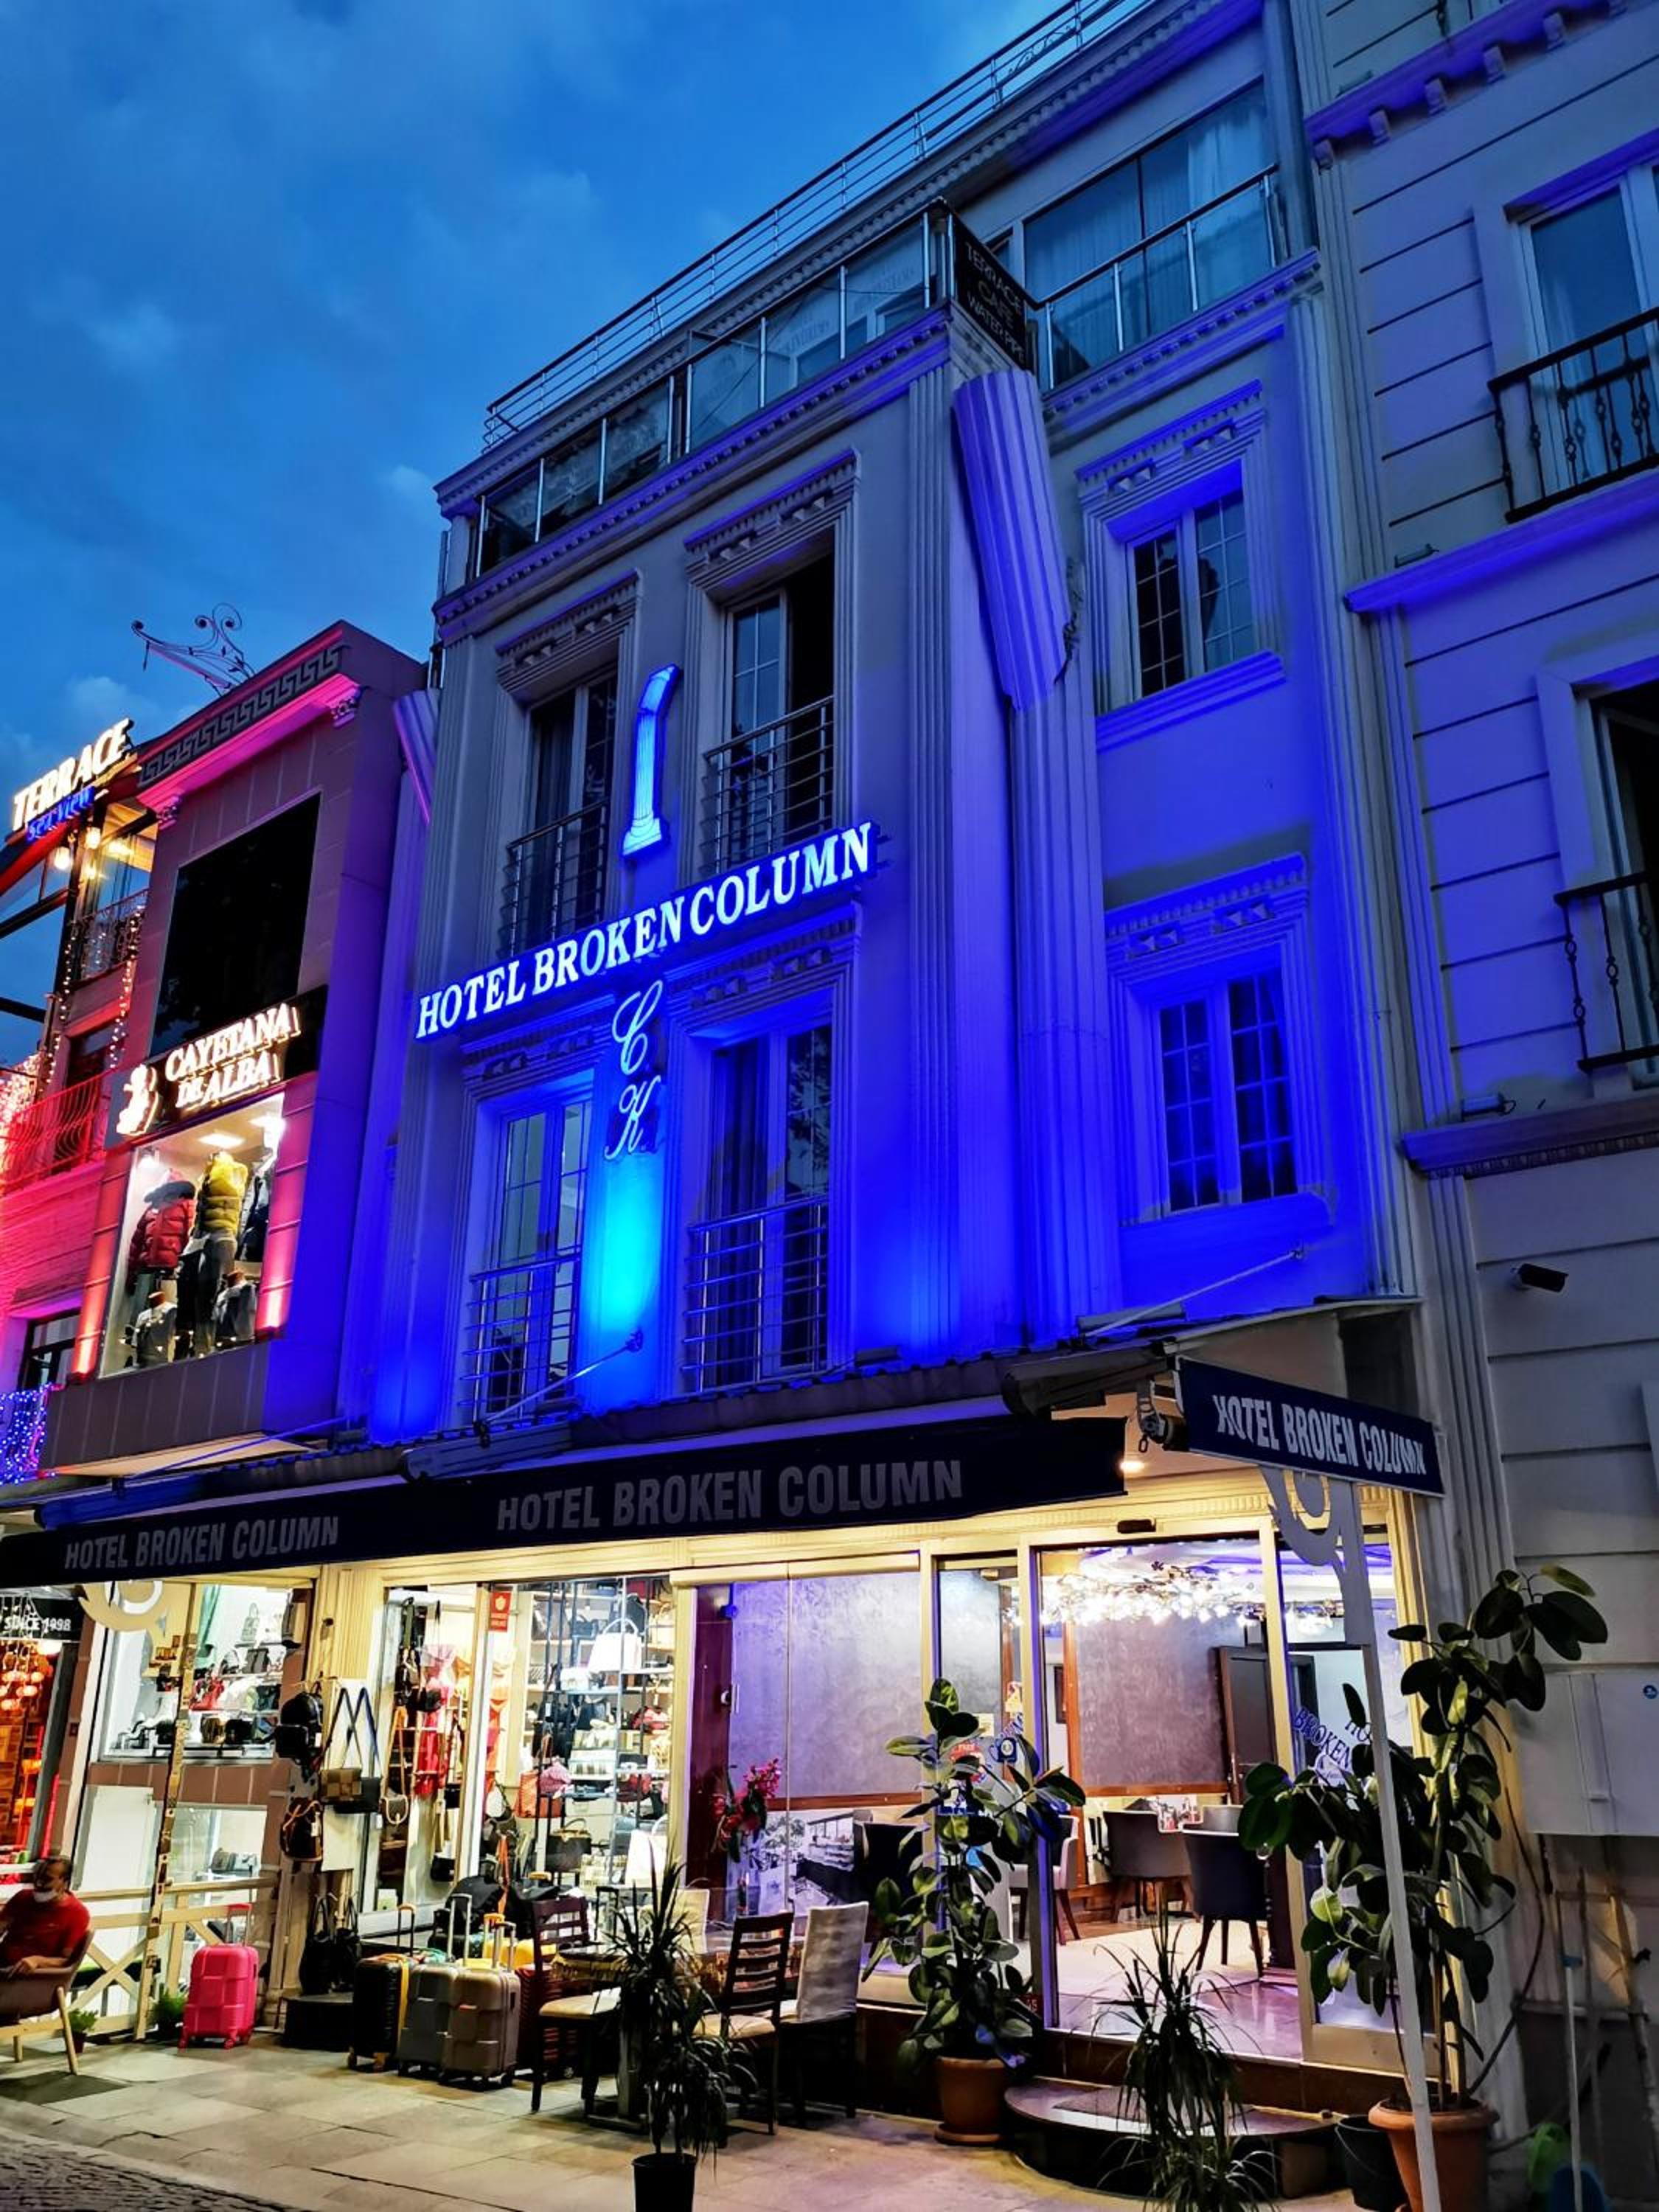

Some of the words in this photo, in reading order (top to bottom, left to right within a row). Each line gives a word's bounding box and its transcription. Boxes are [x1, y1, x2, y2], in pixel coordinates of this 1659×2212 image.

[13, 717, 131, 831] TERRACE
[415, 960, 526, 1039] HOTEL
[532, 895, 684, 995] BROKEN
[689, 821, 872, 936] COLUMN
[164, 1002, 296, 1082] CAYETANA
[201, 1049, 276, 1107] ALBA
[1213, 1394, 1279, 1450] HOTEL
[1282, 1403, 1359, 1467] BROKEN
[1359, 1422, 1427, 1475] COLUMN
[496, 1486, 600, 1531] HOTEL
[612, 1469, 762, 1528] BROKEN
[778, 1460, 961, 1519] COLUMN
[64, 1534, 128, 1570] HOTEL
[135, 1523, 223, 1568] BROKEN
[232, 1515, 339, 1559] COLUMN
[4, 1614, 41, 1631] SINCE
[42, 1617, 72, 1633] 1998
[1294, 1708, 1351, 1769] BROKEN
